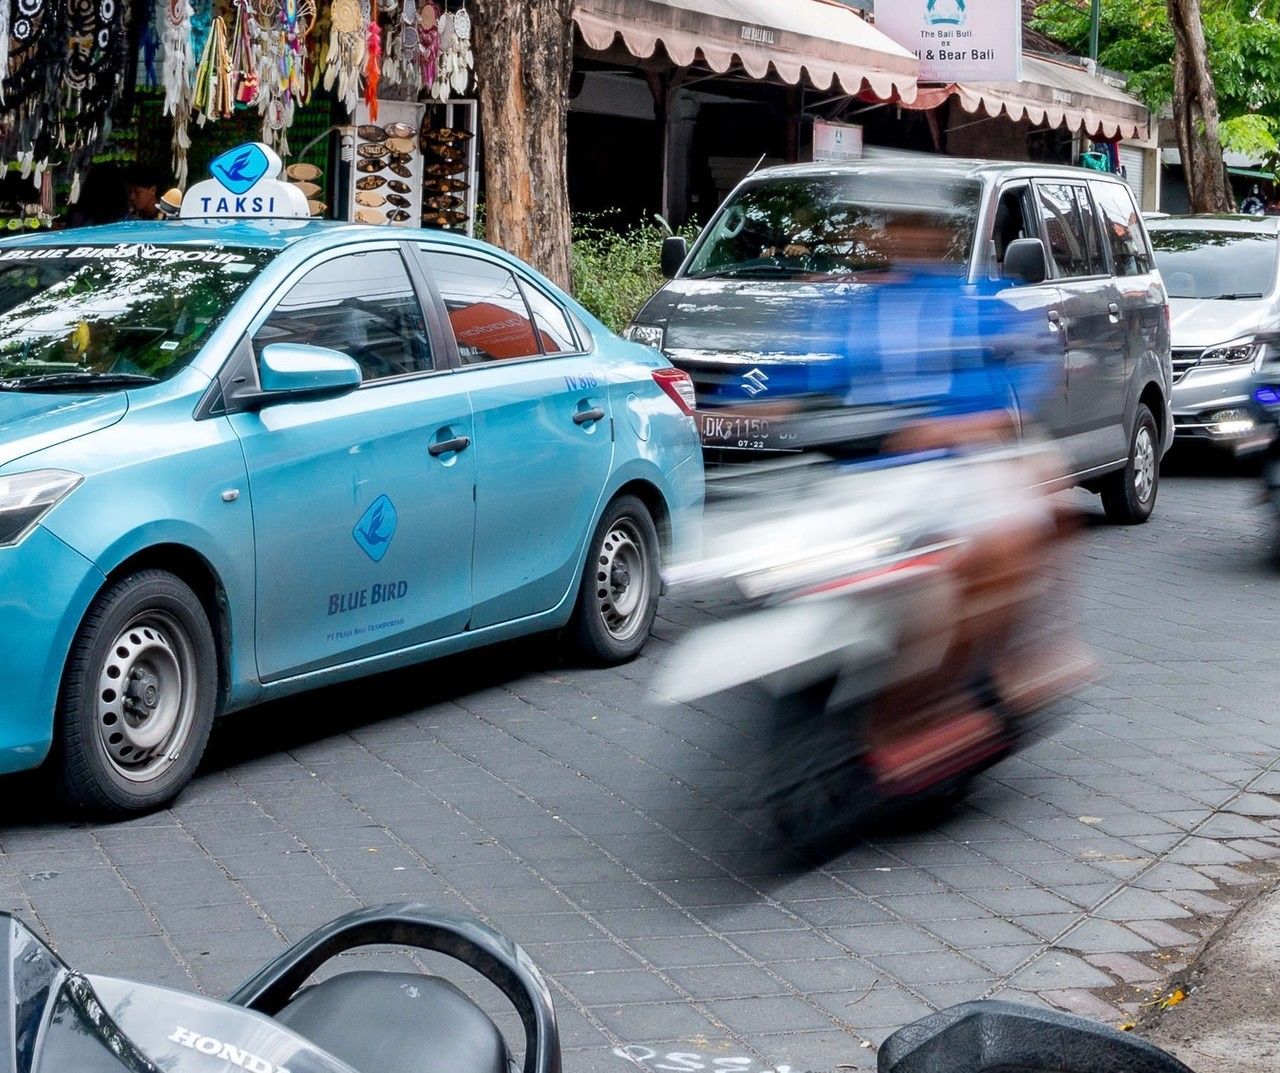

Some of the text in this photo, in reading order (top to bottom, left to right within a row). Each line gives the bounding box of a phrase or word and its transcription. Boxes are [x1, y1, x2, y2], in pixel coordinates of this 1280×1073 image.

[920, 29, 972, 38] The Bali Bull
[926, 50, 934, 60] &
[939, 50, 966, 60] Bear
[971, 49, 994, 60] Bali
[201, 197, 274, 212] TAKSI
[69, 247, 134, 258] BIRD
[147, 248, 246, 265] GROUP
[706, 417, 724, 437] DK
[327, 581, 408, 616] BLUE BIRD
